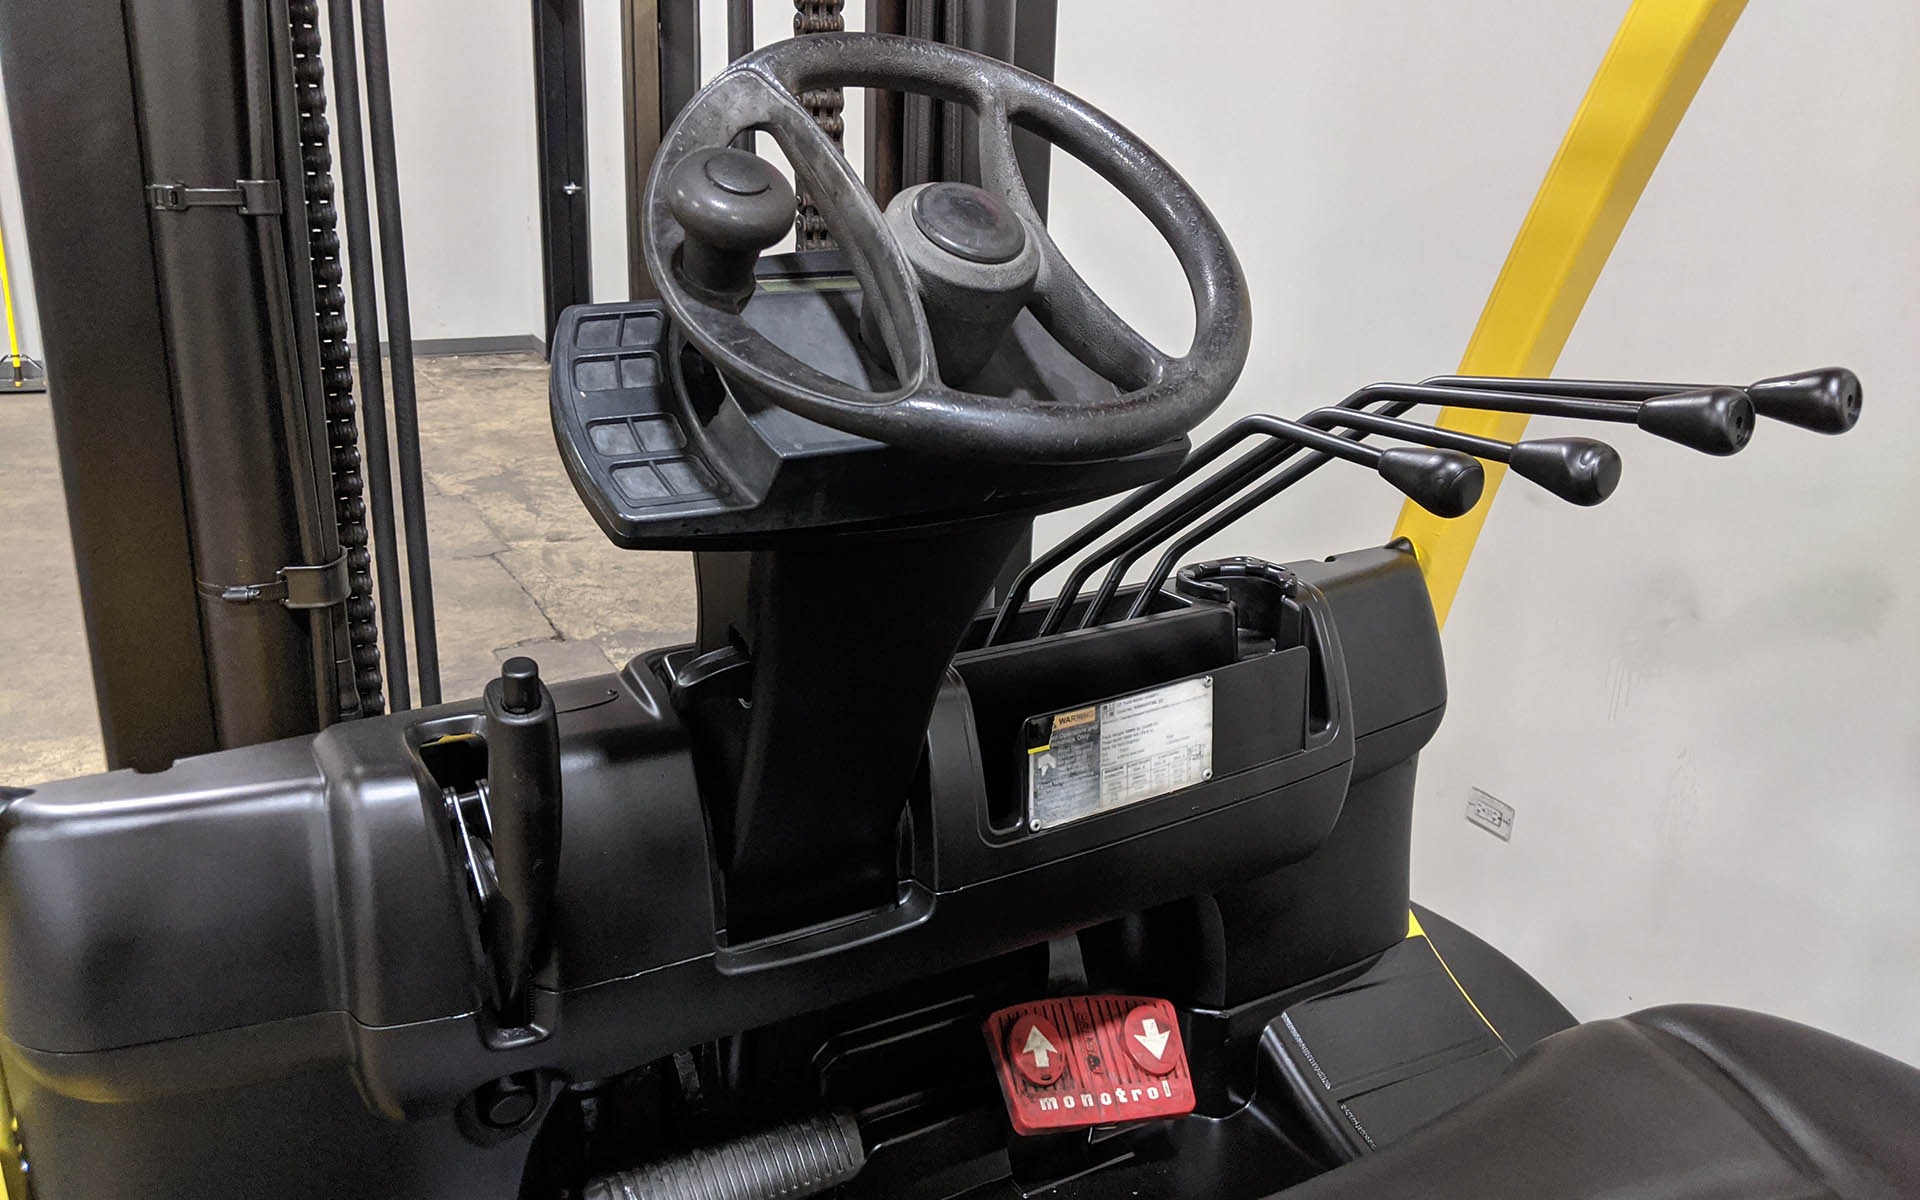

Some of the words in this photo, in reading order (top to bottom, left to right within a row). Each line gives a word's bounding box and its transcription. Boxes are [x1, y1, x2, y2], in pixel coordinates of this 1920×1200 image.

[1058, 710, 1095, 725] WARNING
[1076, 1012, 1104, 1076] STER
[1040, 1080, 1172, 1111] monotrol
